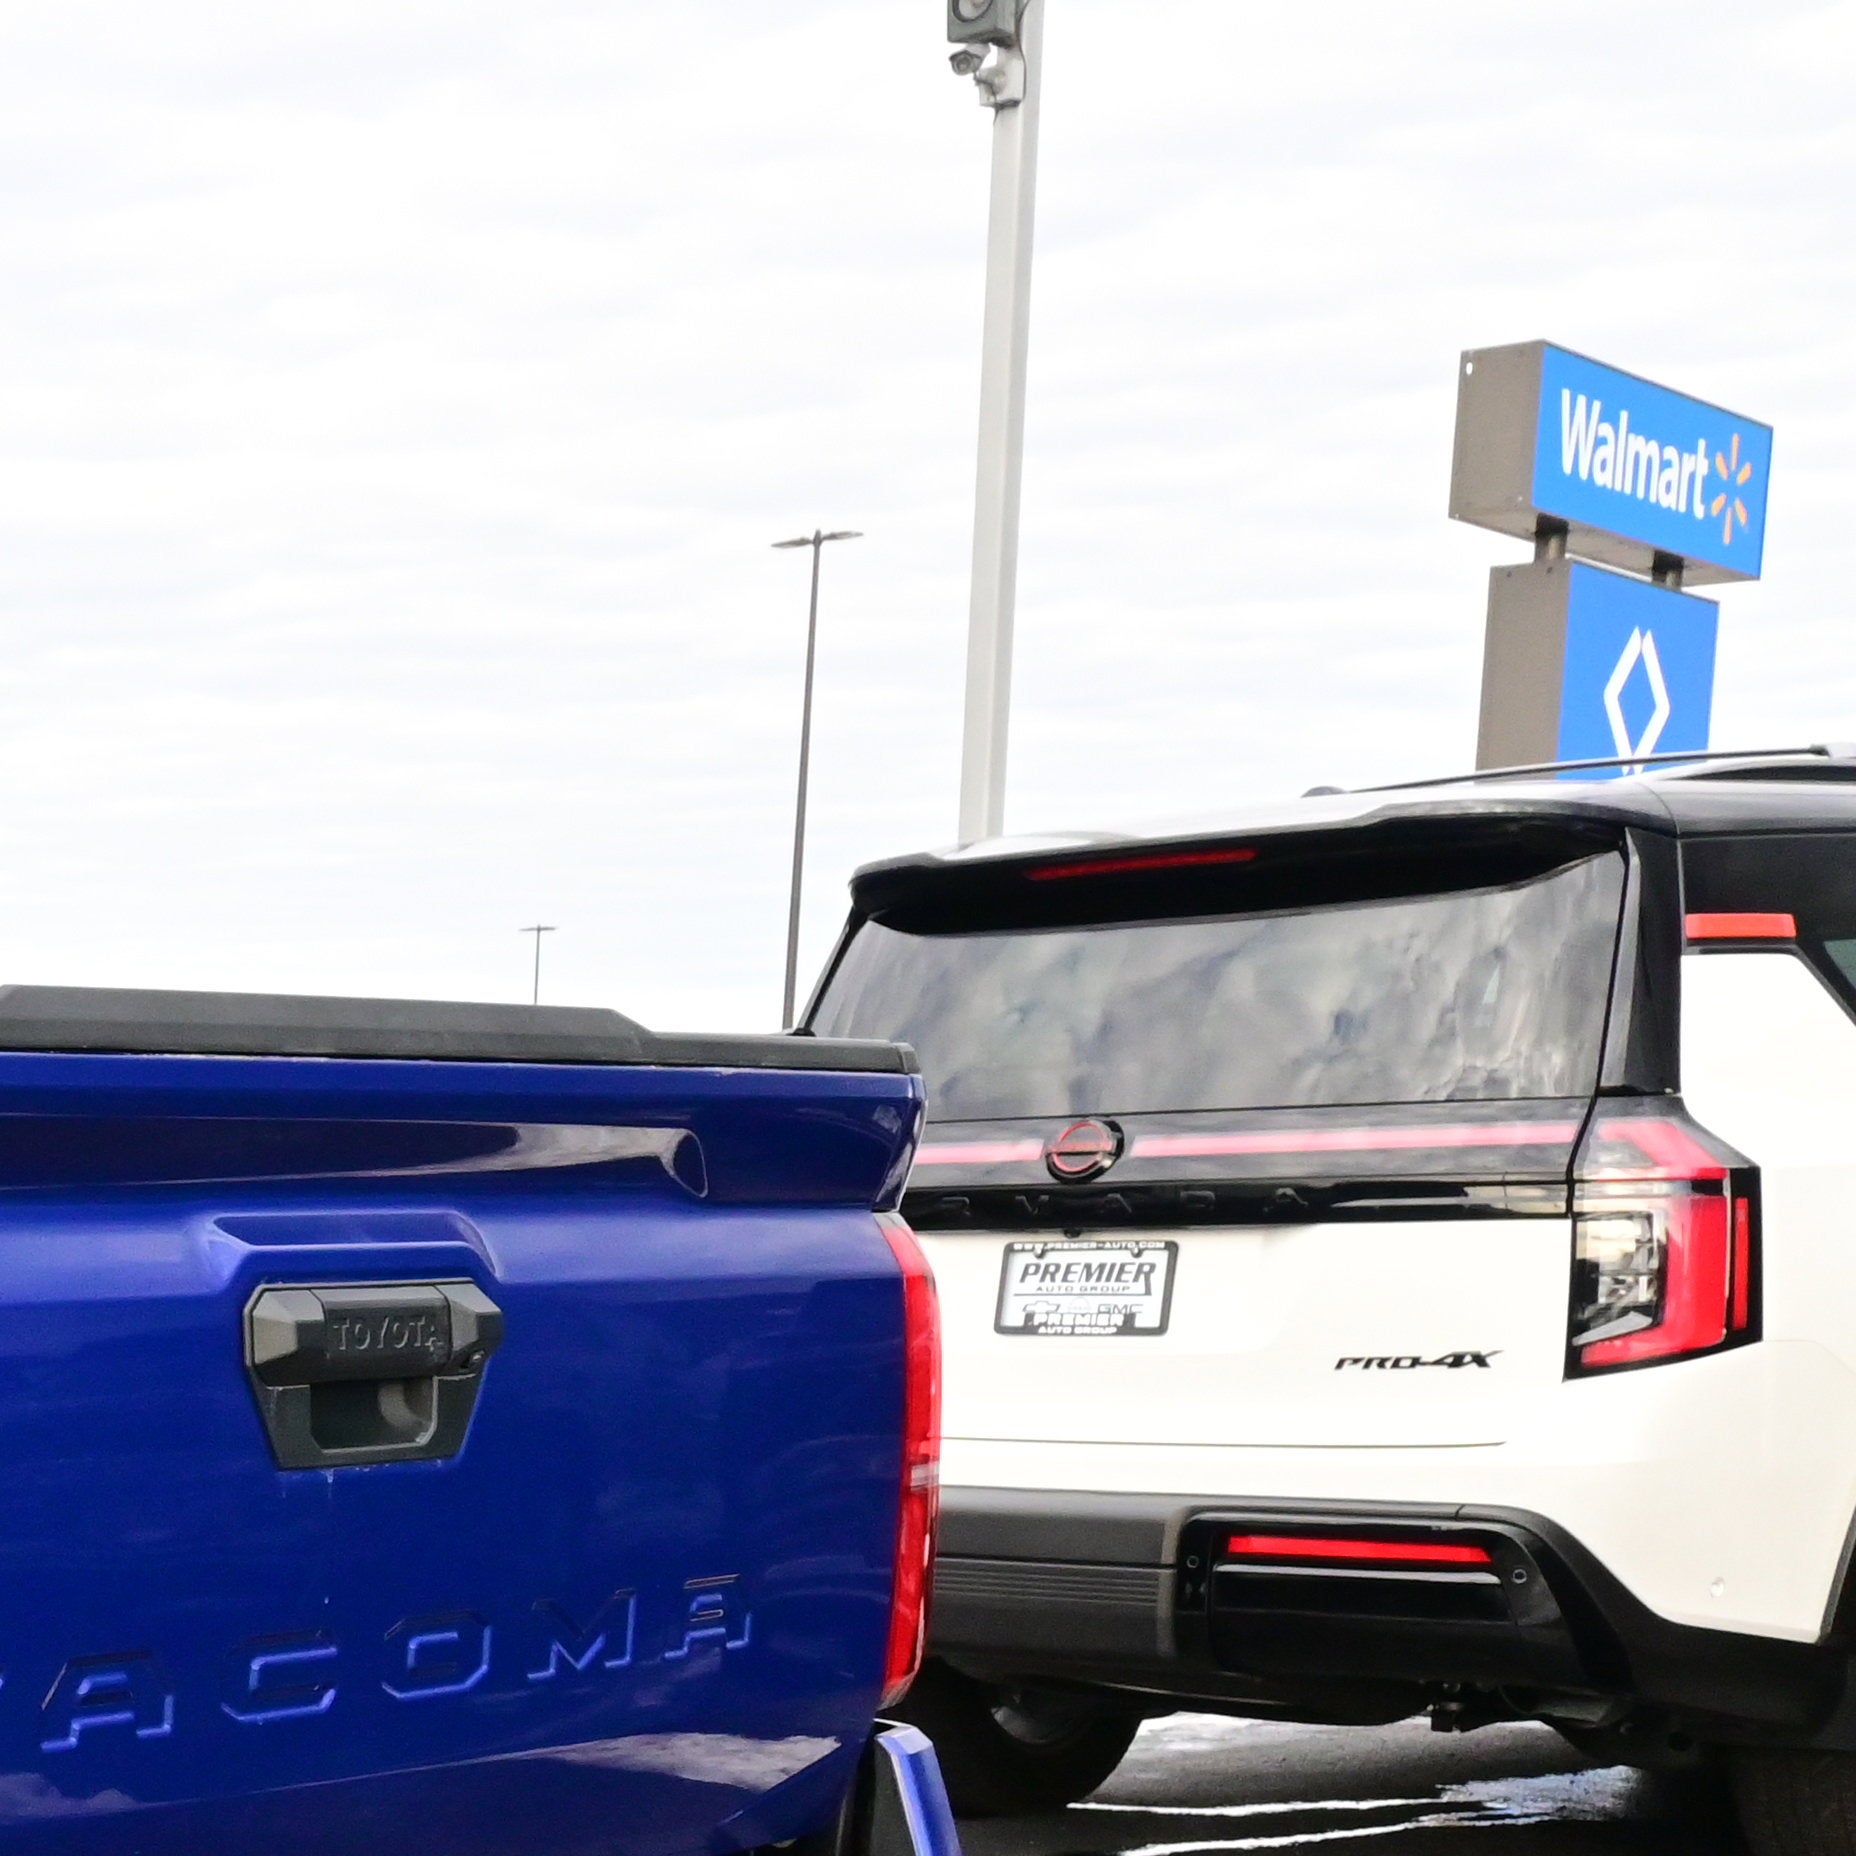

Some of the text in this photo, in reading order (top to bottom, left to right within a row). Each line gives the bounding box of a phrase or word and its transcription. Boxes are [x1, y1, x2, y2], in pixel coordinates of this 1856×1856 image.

[1561, 387, 1709, 520] Walmart
[1019, 1262, 1157, 1295] PREMIER
[1097, 1304, 1144, 1313] GMC
[1034, 1313, 1124, 1327] PREMIER
[1038, 1326, 1118, 1334] AUTO GROUP
[333, 1314, 444, 1352] TOYOTA
[1334, 1350, 1503, 1370] PRO-4X
